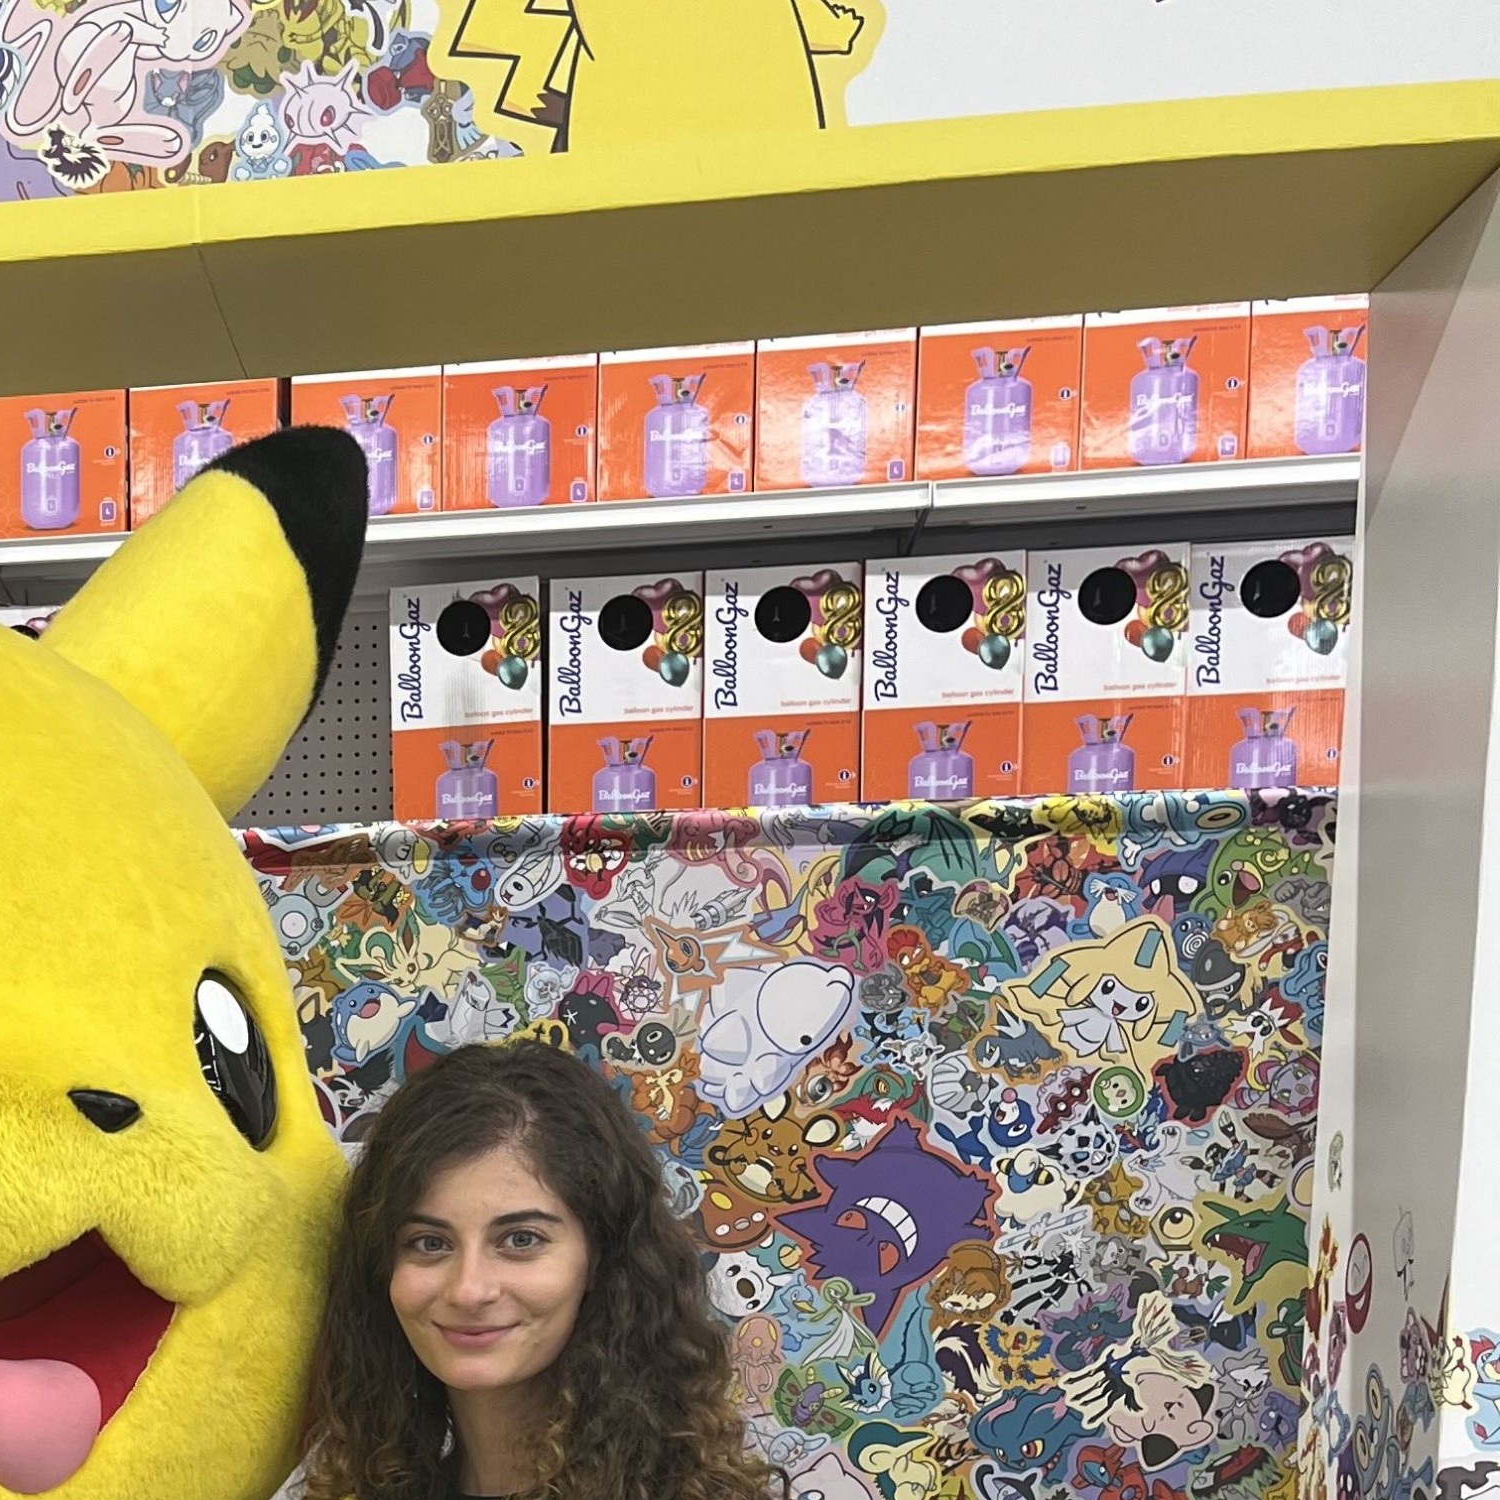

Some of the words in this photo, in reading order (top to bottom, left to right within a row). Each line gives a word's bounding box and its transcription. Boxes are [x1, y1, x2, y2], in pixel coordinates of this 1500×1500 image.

[398, 597, 431, 722] BalloonGaz
[558, 590, 592, 716] BalloonGaz
[713, 582, 749, 710] BalloonGaz
[872, 571, 910, 701] BalloonGaz
[1033, 563, 1072, 695] BalloonGaz
[1195, 556, 1235, 687] BalloonGaz
